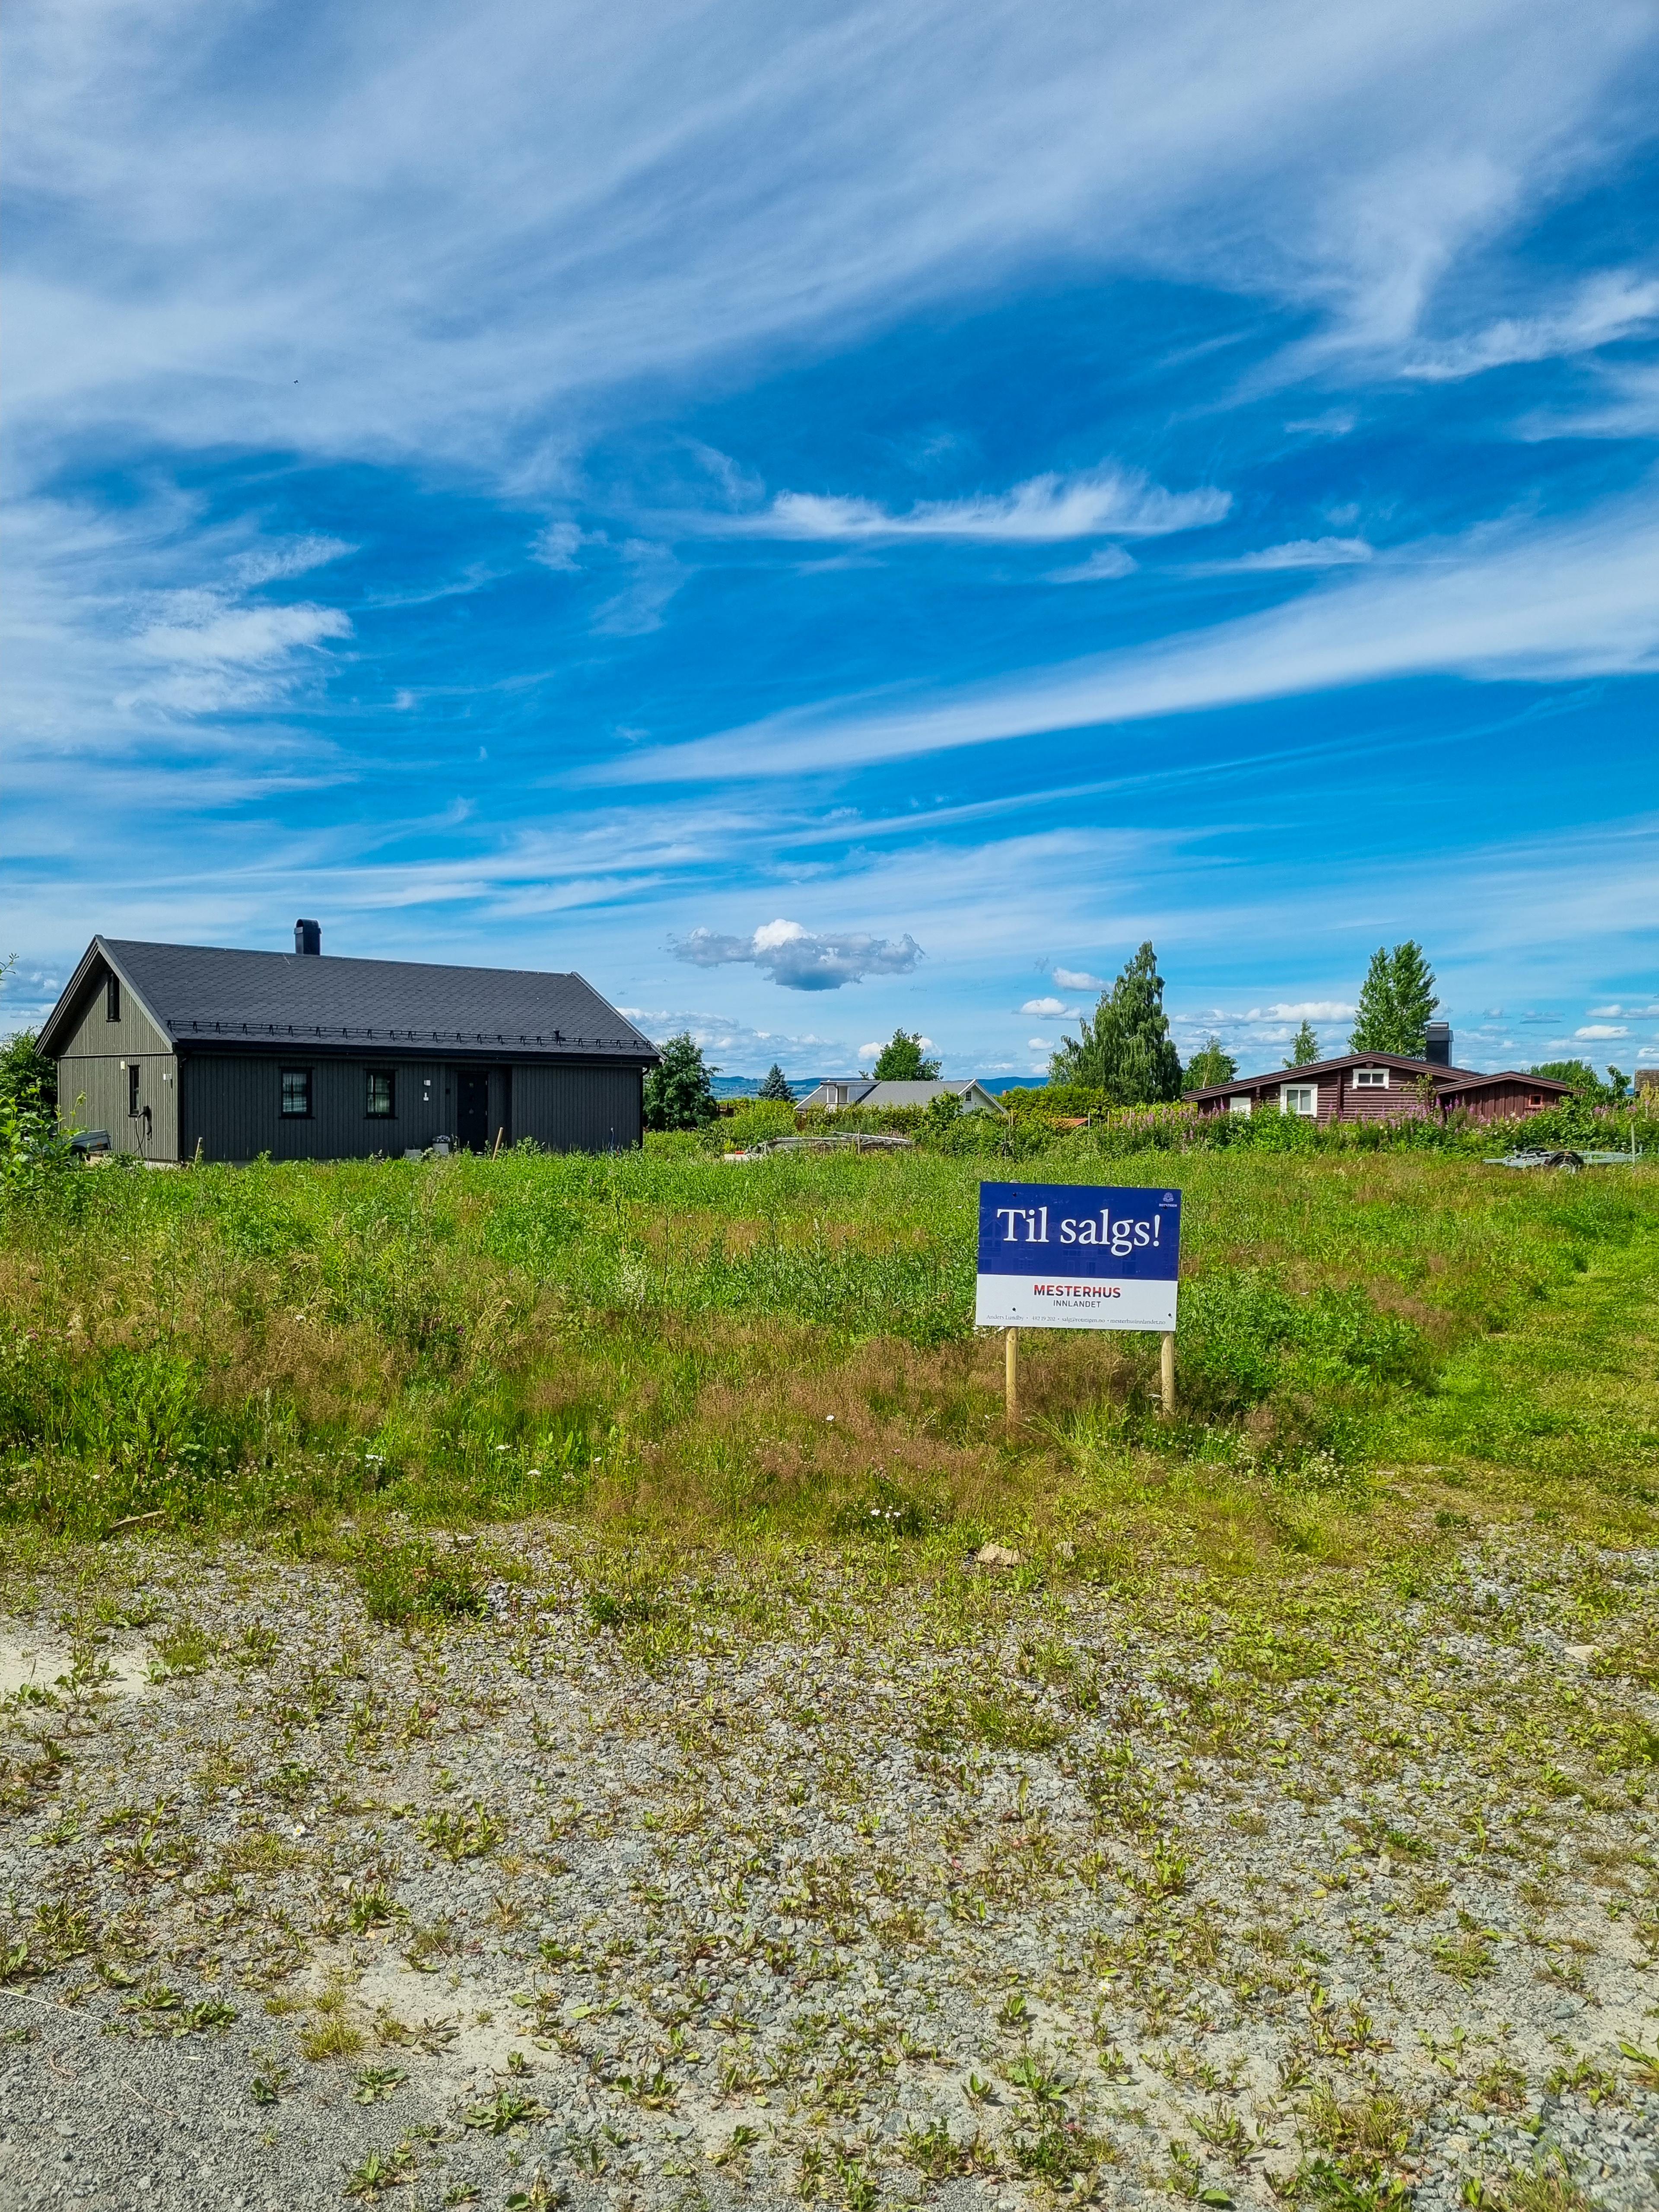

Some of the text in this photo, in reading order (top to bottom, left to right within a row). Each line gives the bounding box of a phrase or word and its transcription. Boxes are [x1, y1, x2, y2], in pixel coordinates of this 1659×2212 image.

[997, 1206, 1049, 1243] Til
[1060, 1209, 1160, 1256] salgs!
[1034, 1284, 1121, 1298] MESTERHUS
[1053, 1300, 1101, 1308] INNLANDET
